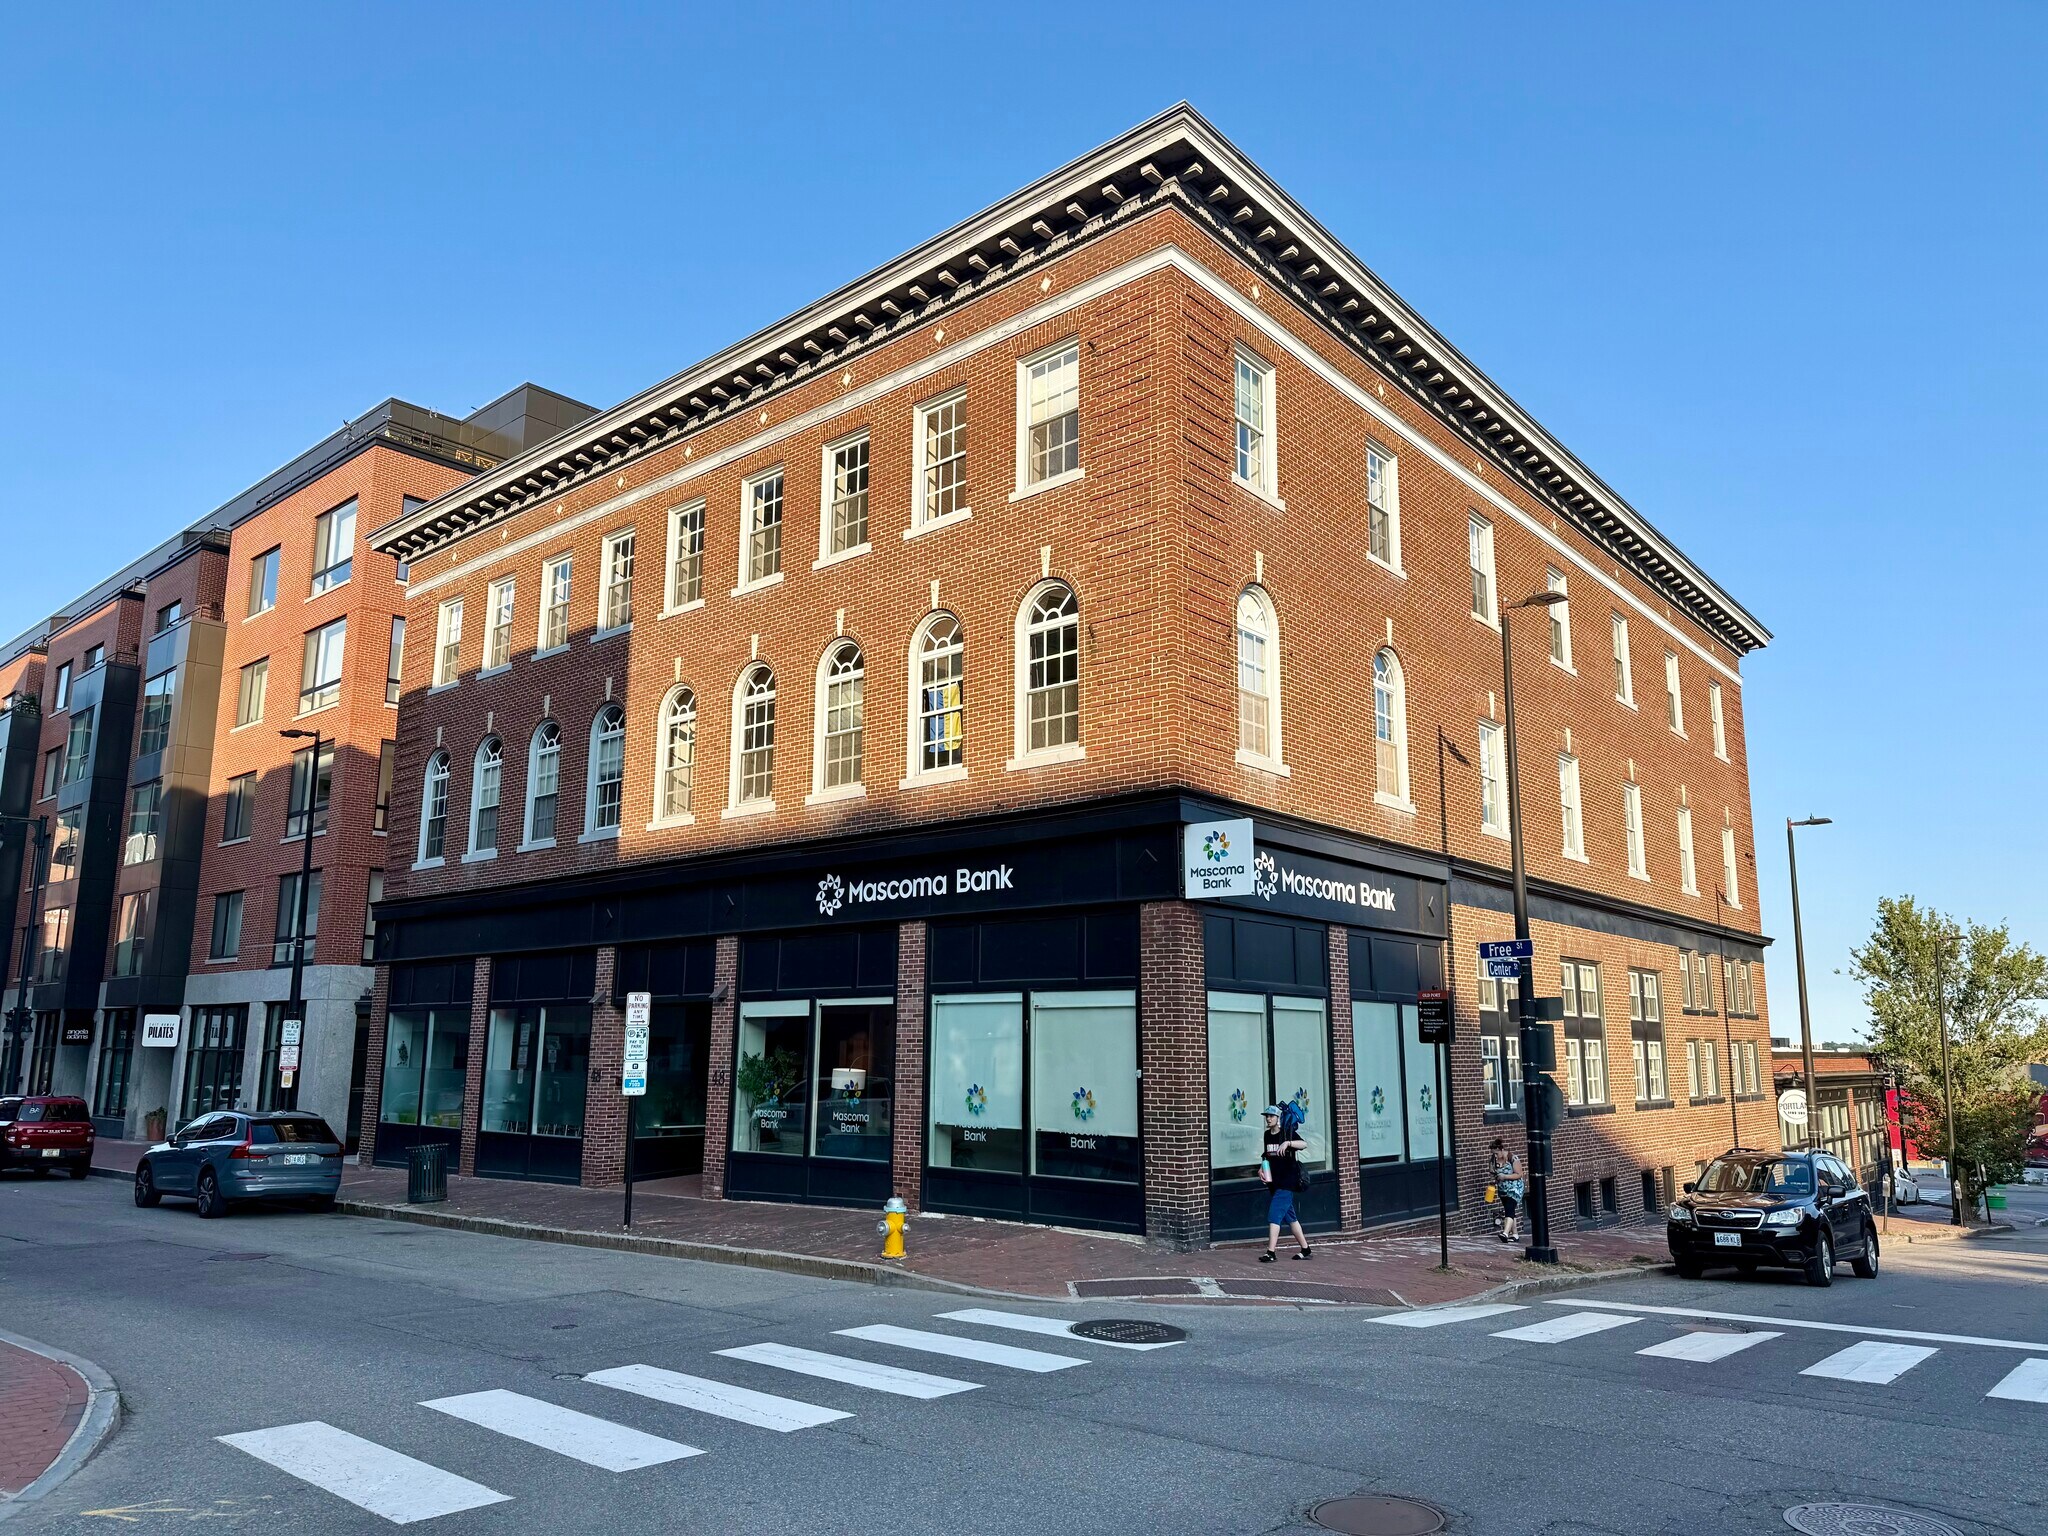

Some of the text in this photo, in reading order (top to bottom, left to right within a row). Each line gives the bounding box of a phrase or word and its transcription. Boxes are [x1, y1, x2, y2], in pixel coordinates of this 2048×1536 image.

[1190, 864, 1245, 877] Mascoma
[849, 864, 1014, 903] Mascoma Bank
[1203, 877, 1232, 889] Bank
[1281, 867, 1396, 911] Mascoma Bank
[1489, 943, 1512, 957] Free
[1489, 962, 1511, 975] Center
[147, 1026, 175, 1039] PILATES
[711, 1069, 724, 1086] 48
[754, 1108, 788, 1119] Mascoma
[832, 1111, 870, 1123] Mascoma
[760, 1119, 779, 1129] Bank
[840, 1122, 860, 1133] Bank
[964, 1130, 987, 1142] Bank
[1070, 1136, 1097, 1150] Bank
